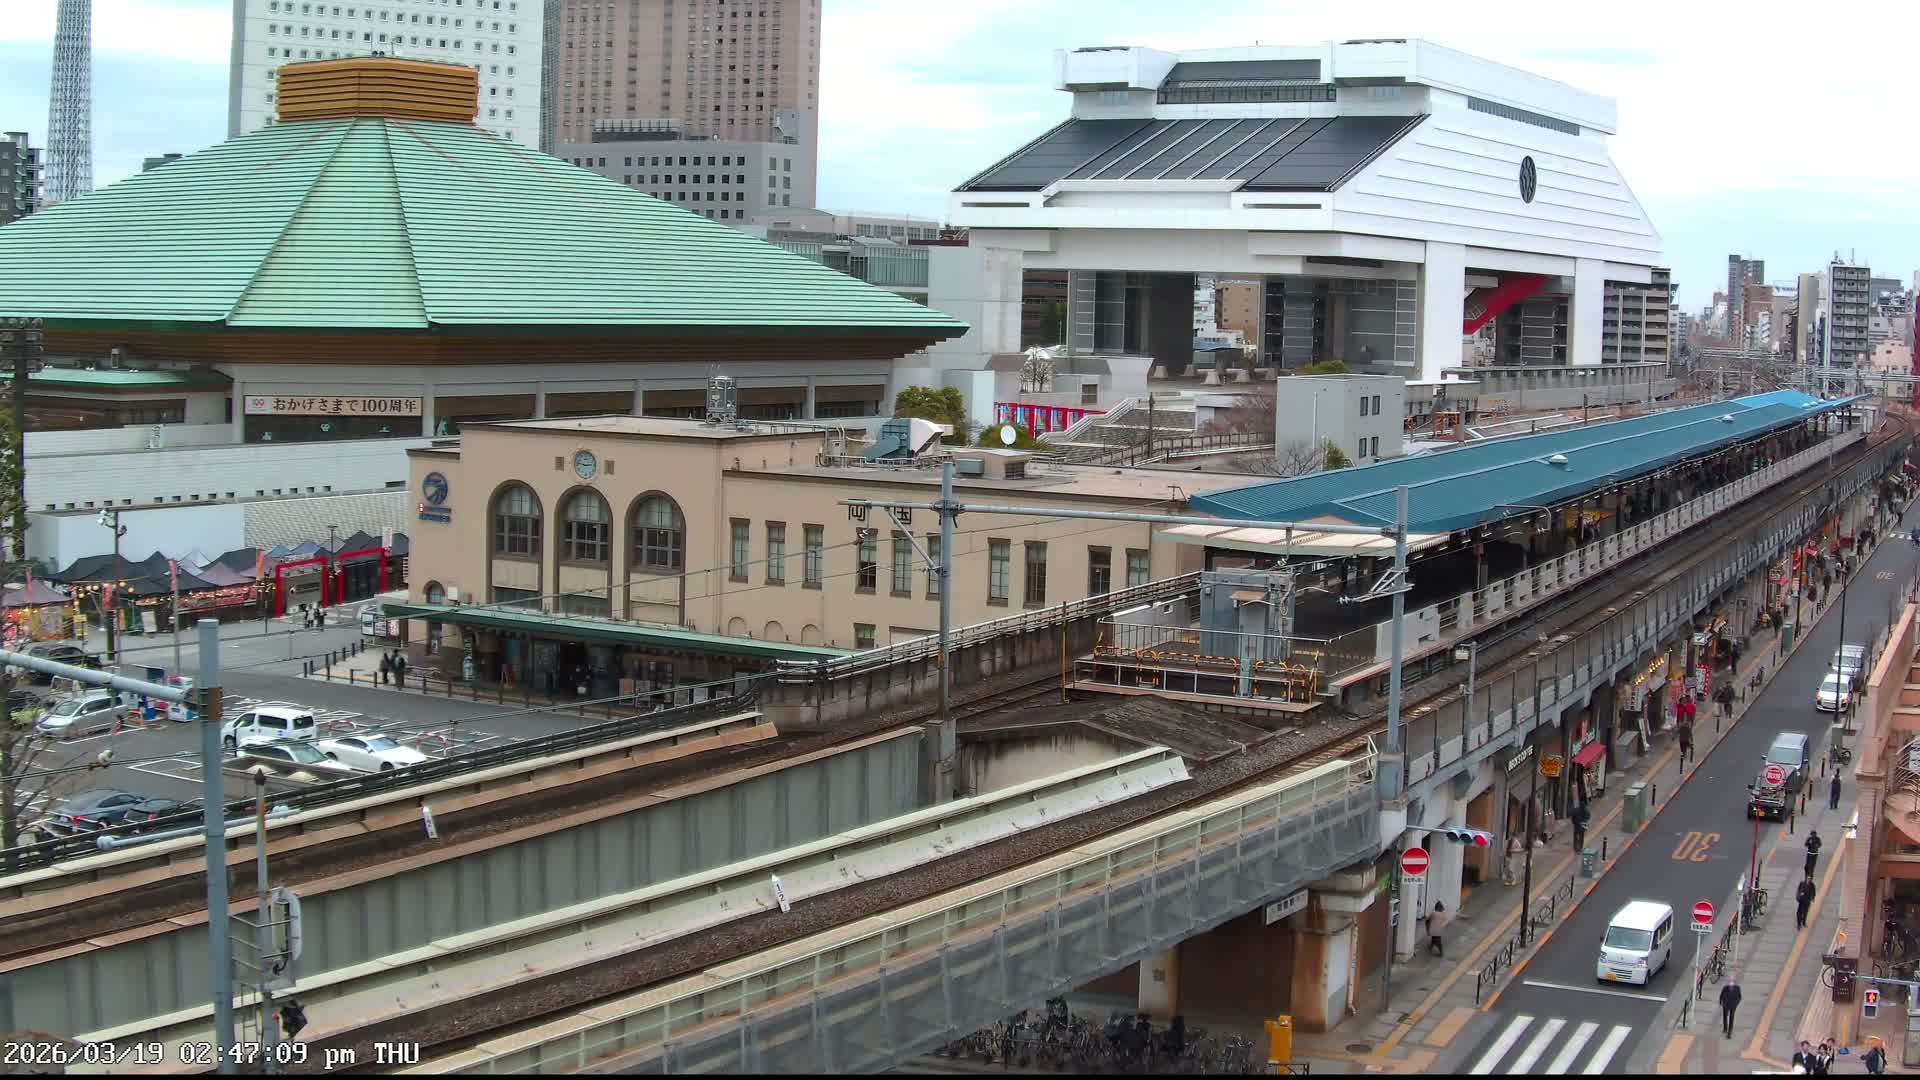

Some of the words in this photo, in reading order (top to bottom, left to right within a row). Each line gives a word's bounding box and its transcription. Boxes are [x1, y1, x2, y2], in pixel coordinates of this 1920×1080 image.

[273, 398, 417, 413] おかげさまで100周年
